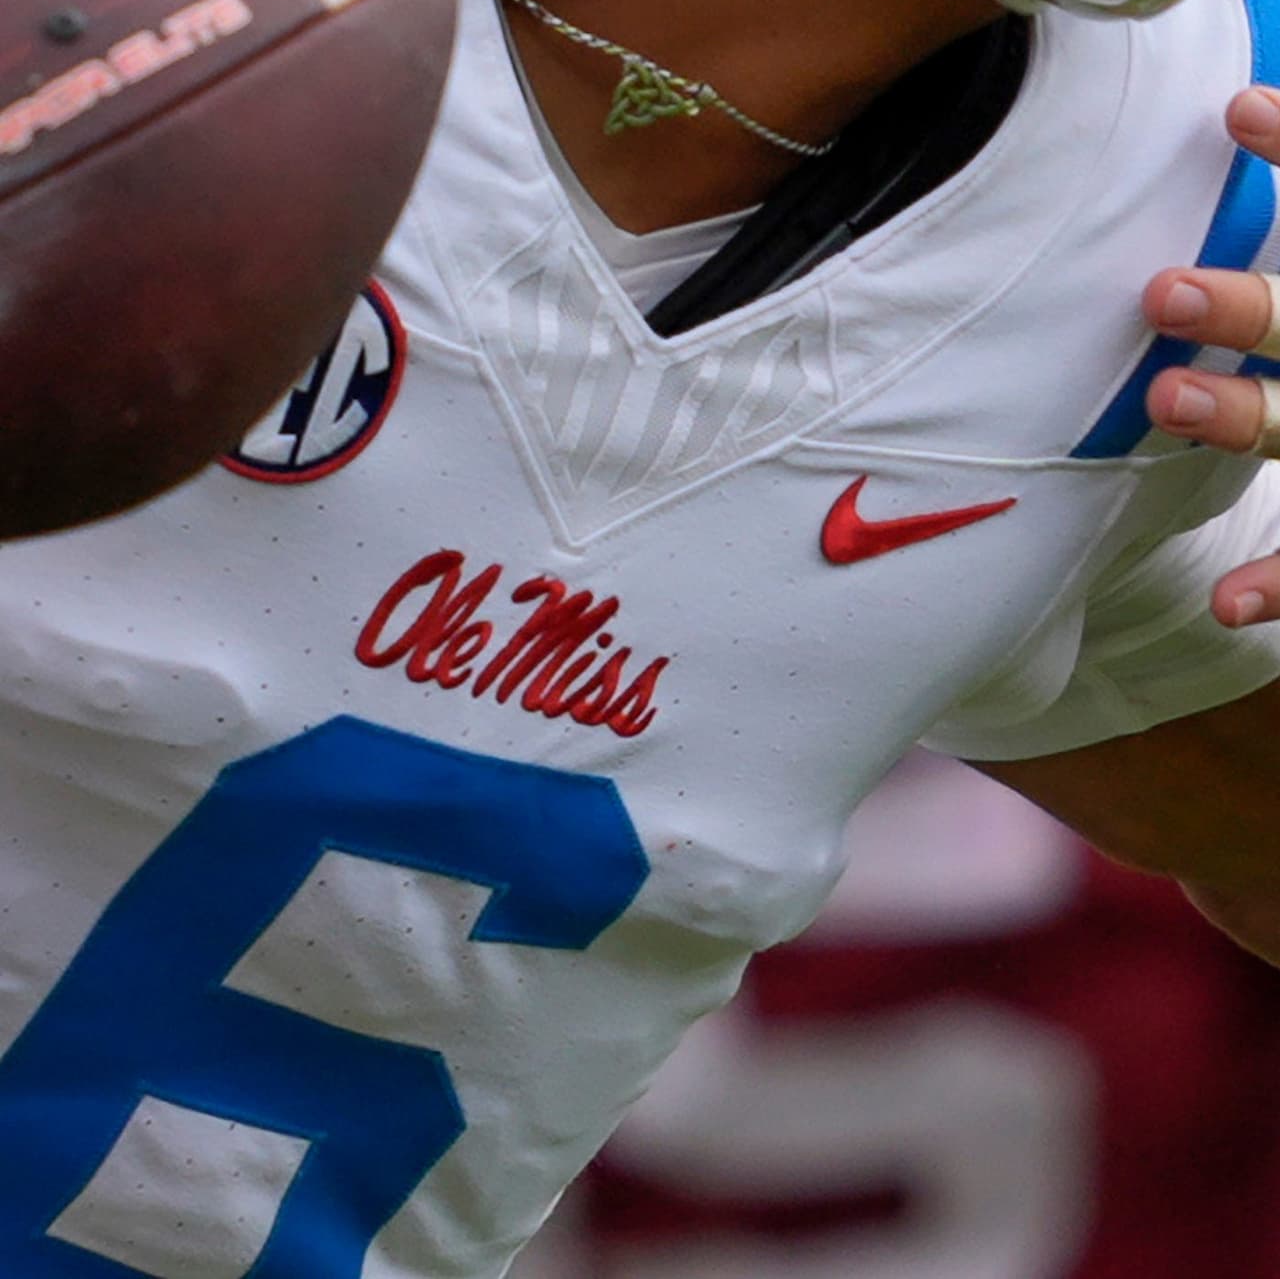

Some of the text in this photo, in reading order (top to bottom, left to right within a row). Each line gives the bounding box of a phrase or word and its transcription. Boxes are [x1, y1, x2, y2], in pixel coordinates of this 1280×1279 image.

[355, 548, 669, 737] Ole Miss
[0, 713, 652, 1279] 6
